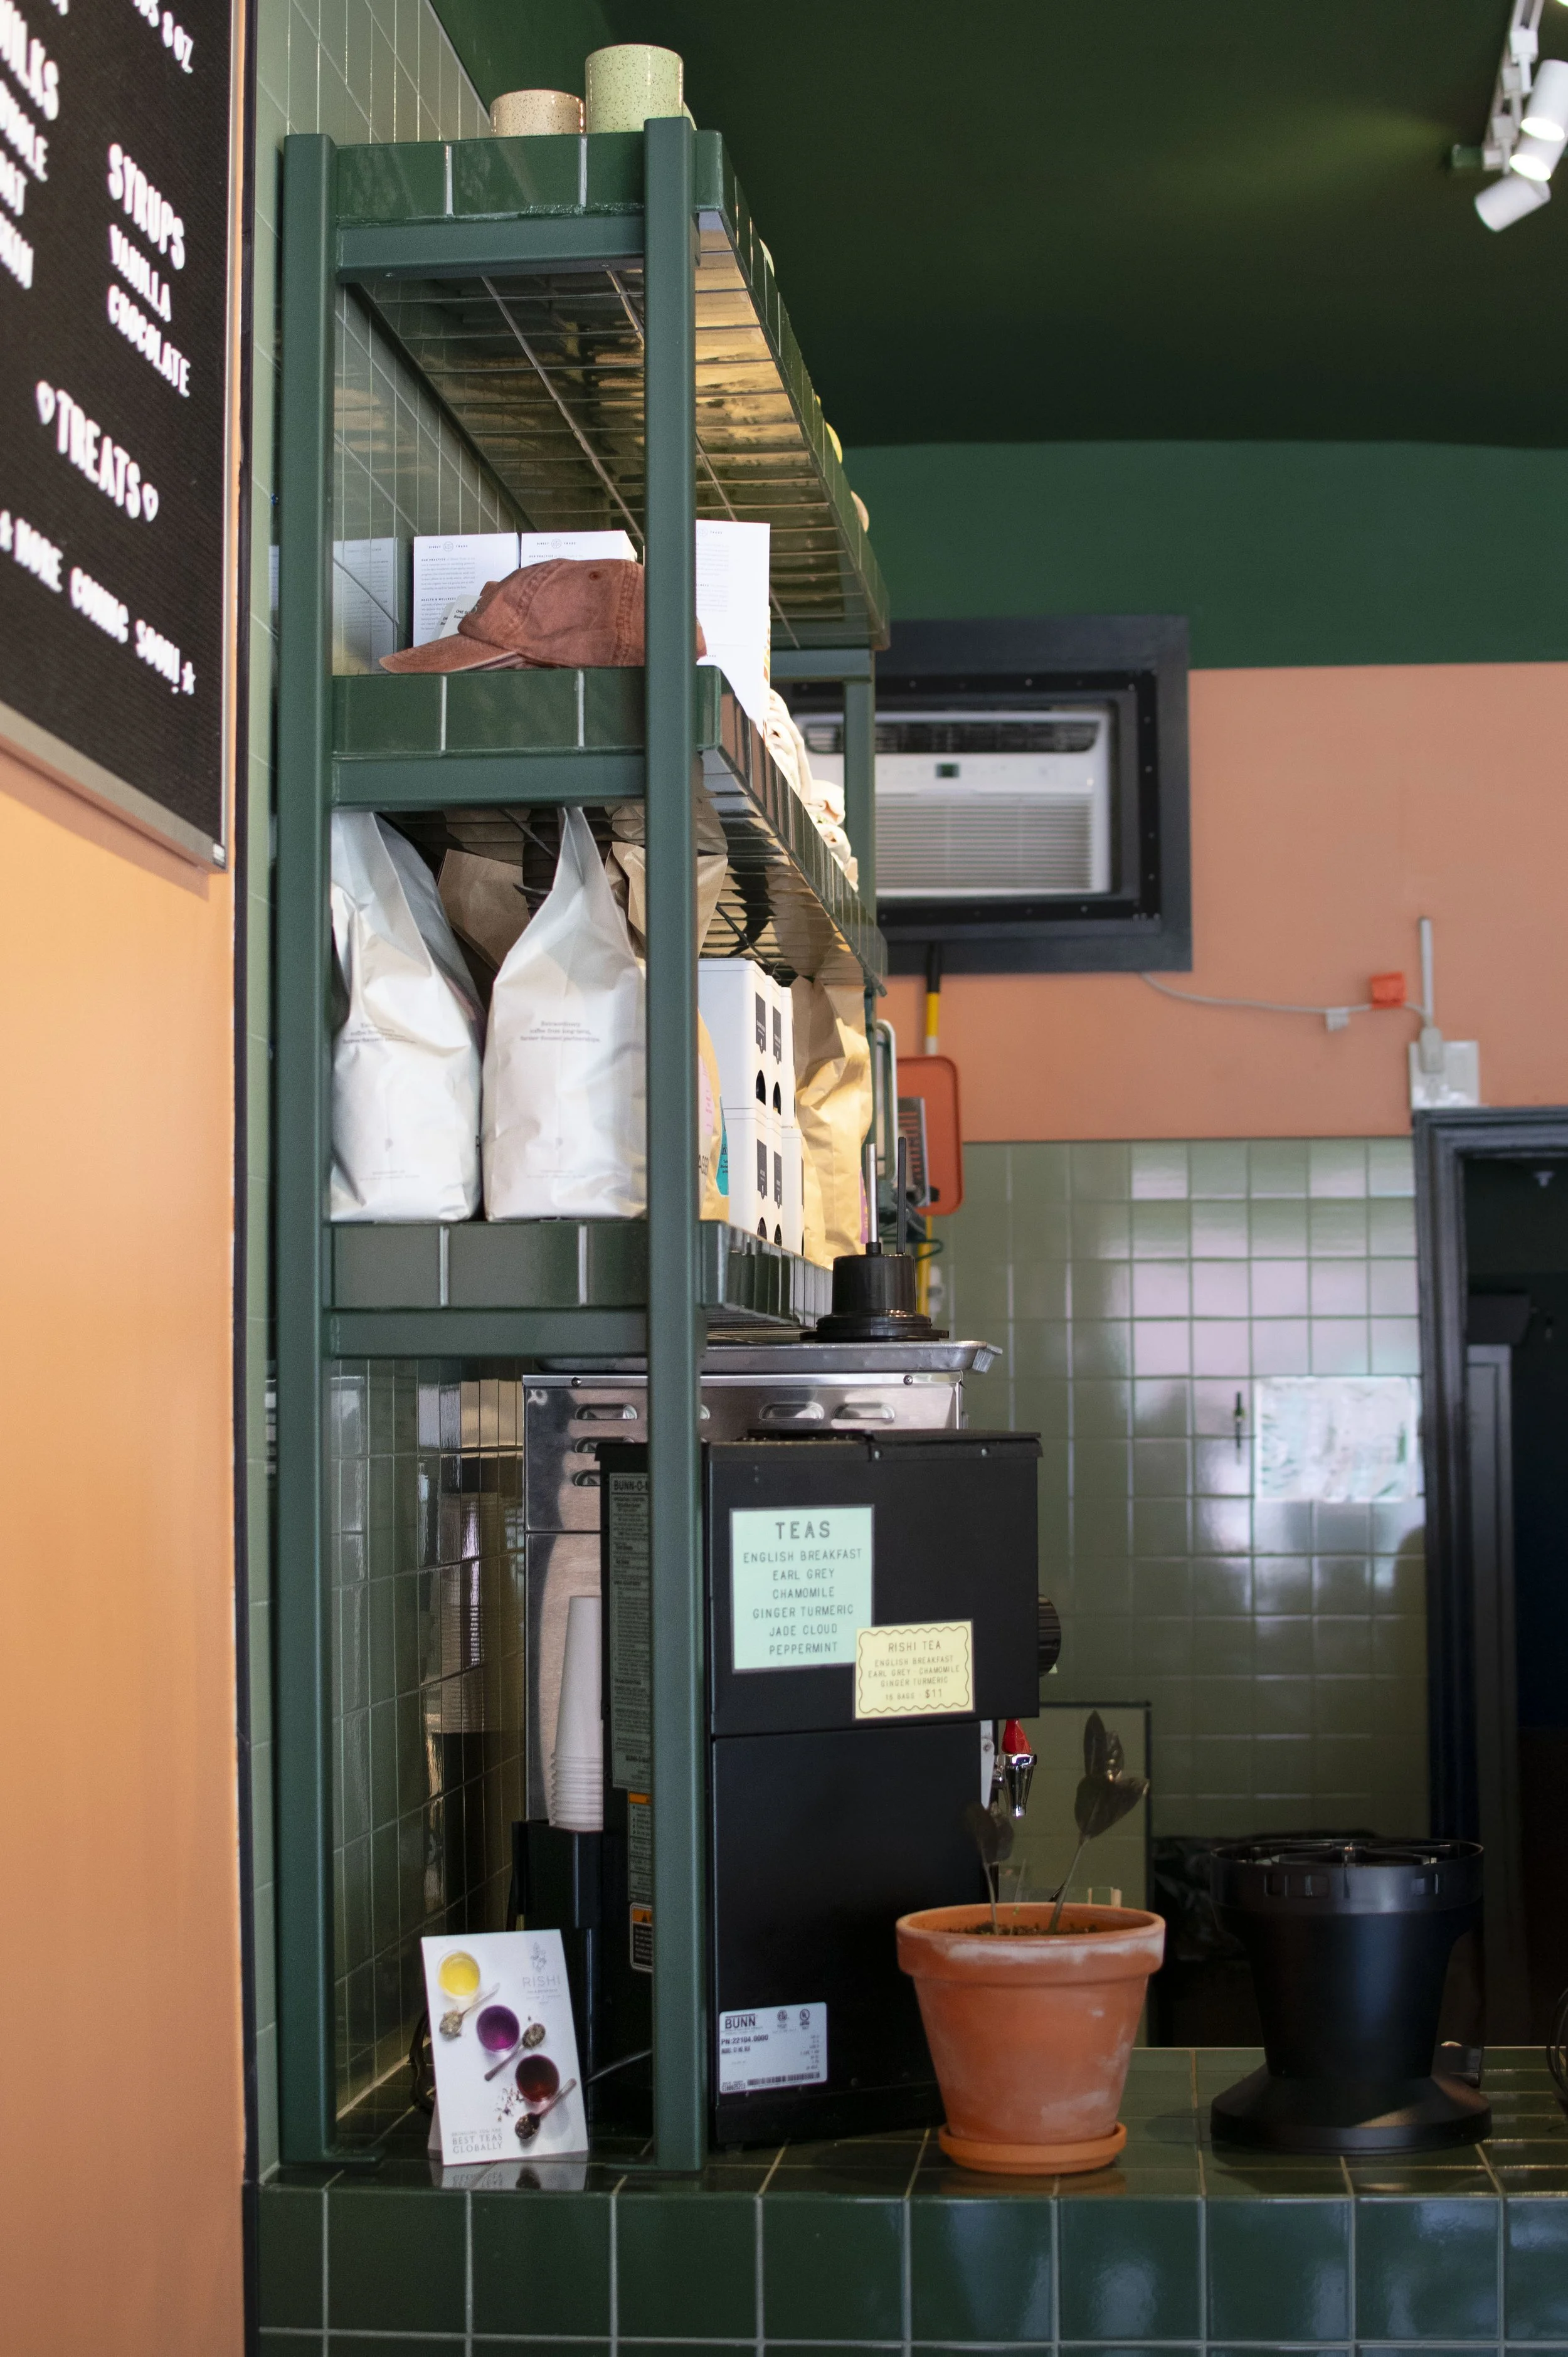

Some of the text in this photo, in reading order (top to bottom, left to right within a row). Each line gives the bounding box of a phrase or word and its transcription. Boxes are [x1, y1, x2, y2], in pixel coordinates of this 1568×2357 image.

[108, 143, 185, 270] SYRUPS
[110, 224, 171, 322] VANILLA
[108, 284, 190, 397] CHOCOLATE
[56, 389, 141, 519] TREATS
[14, 518, 63, 593] MORE
[70, 566, 129, 644] COMING
[775, 1521, 831, 1540] TEAS
[743, 1549, 862, 1564] ENGLISH BREAKFAST
[773, 1569, 835, 1581] EARL GREY
[773, 1587, 835, 1599] CHAMOMILE
[753, 1604, 854, 1619] GINGER TURMERIC
[769, 1623, 838, 1637] JADE CLOUD
[769, 1641, 838, 1655] PEPPERMINT
[888, 1640, 941, 1653] RISHI TEA
[874, 1655, 953, 1667] ENGLISH BREAKFAST
[891, 1668, 911, 1676] GREY
[919, 1665, 960, 1675] CHAMOMILE
[881, 1676, 948, 1687] GINGER TURMERIC
[925, 1688, 942, 1698] $11
[522, 1974, 561, 1988] RISHI
[725, 2015, 756, 2029] BUNN
[452, 2132, 502, 2146] BEST TEAS
[453, 2141, 503, 2154] GLOBALLY
